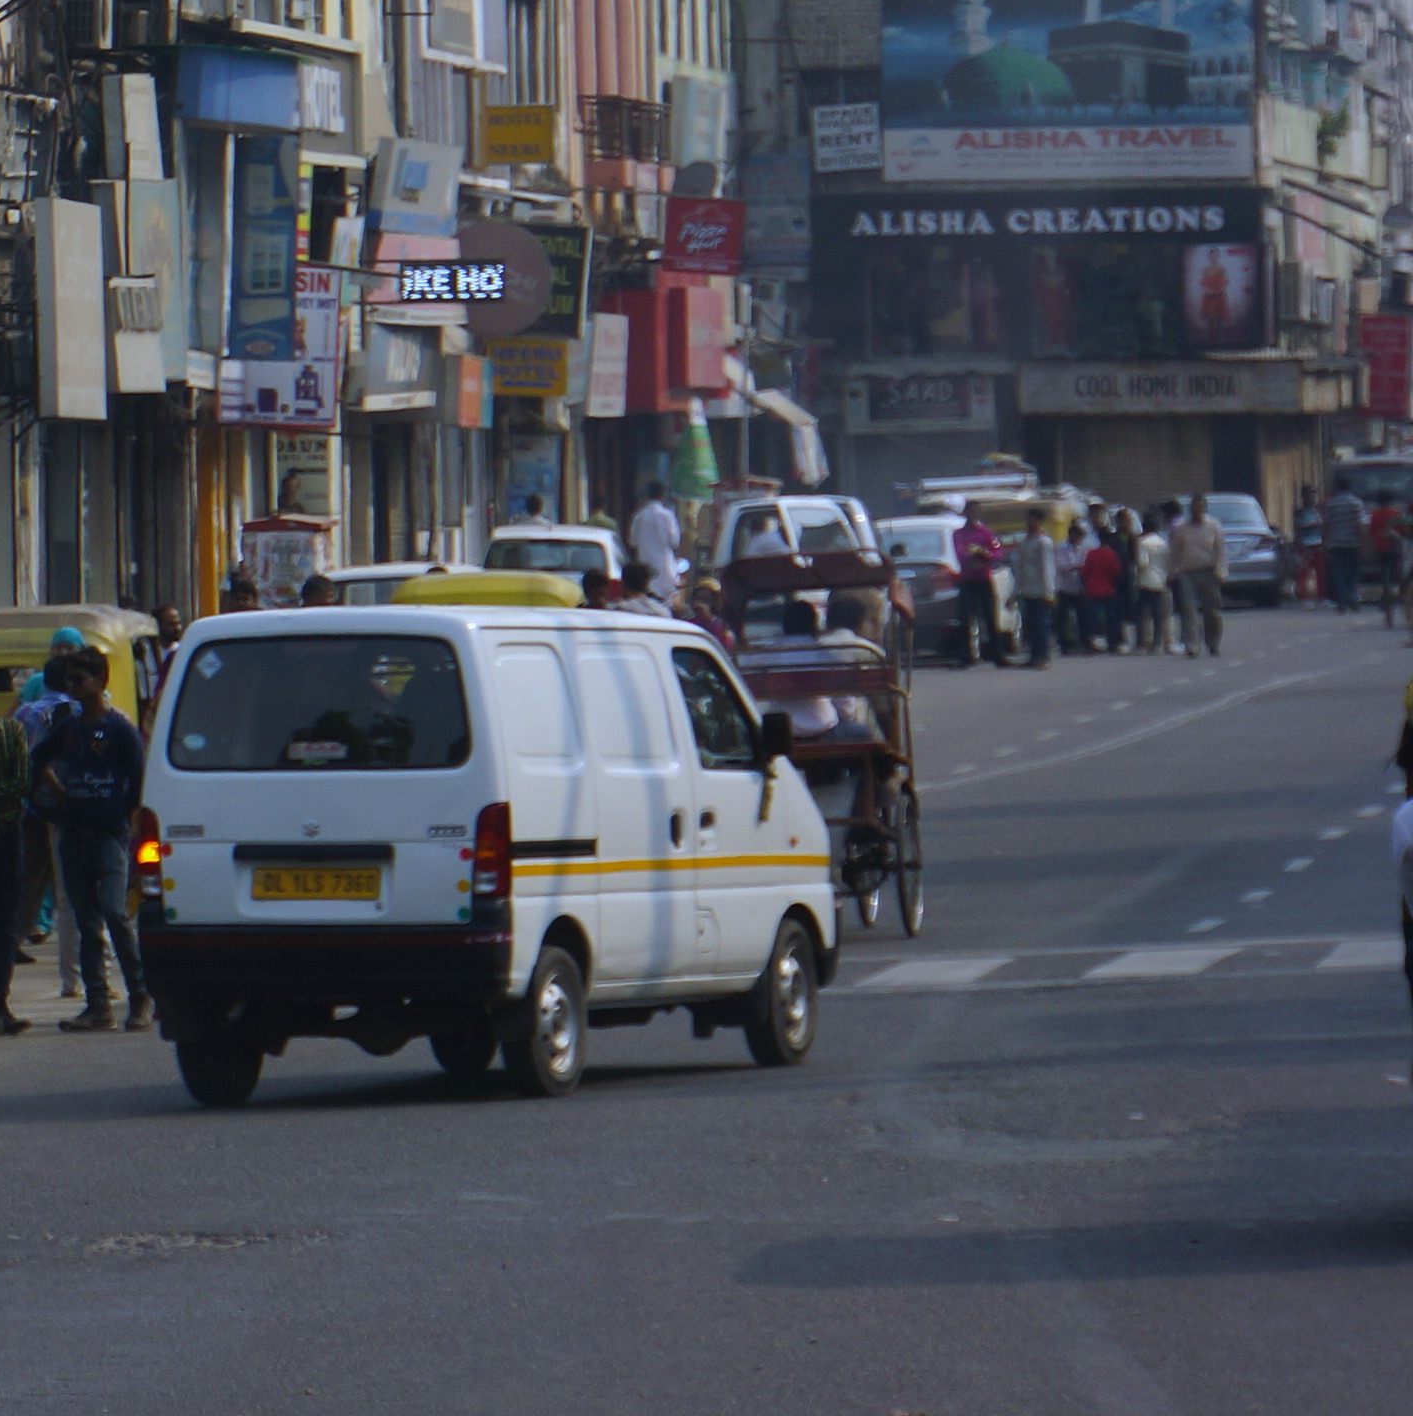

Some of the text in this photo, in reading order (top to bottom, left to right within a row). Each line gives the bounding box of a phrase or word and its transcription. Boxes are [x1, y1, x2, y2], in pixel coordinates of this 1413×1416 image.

[820, 133, 874, 146] RENT
[956, 127, 1236, 150] ALISHA TRAVEL
[849, 205, 1226, 236] ALISHA CREATIONS
[1076, 374, 1238, 399] COOL HOME INDIA
